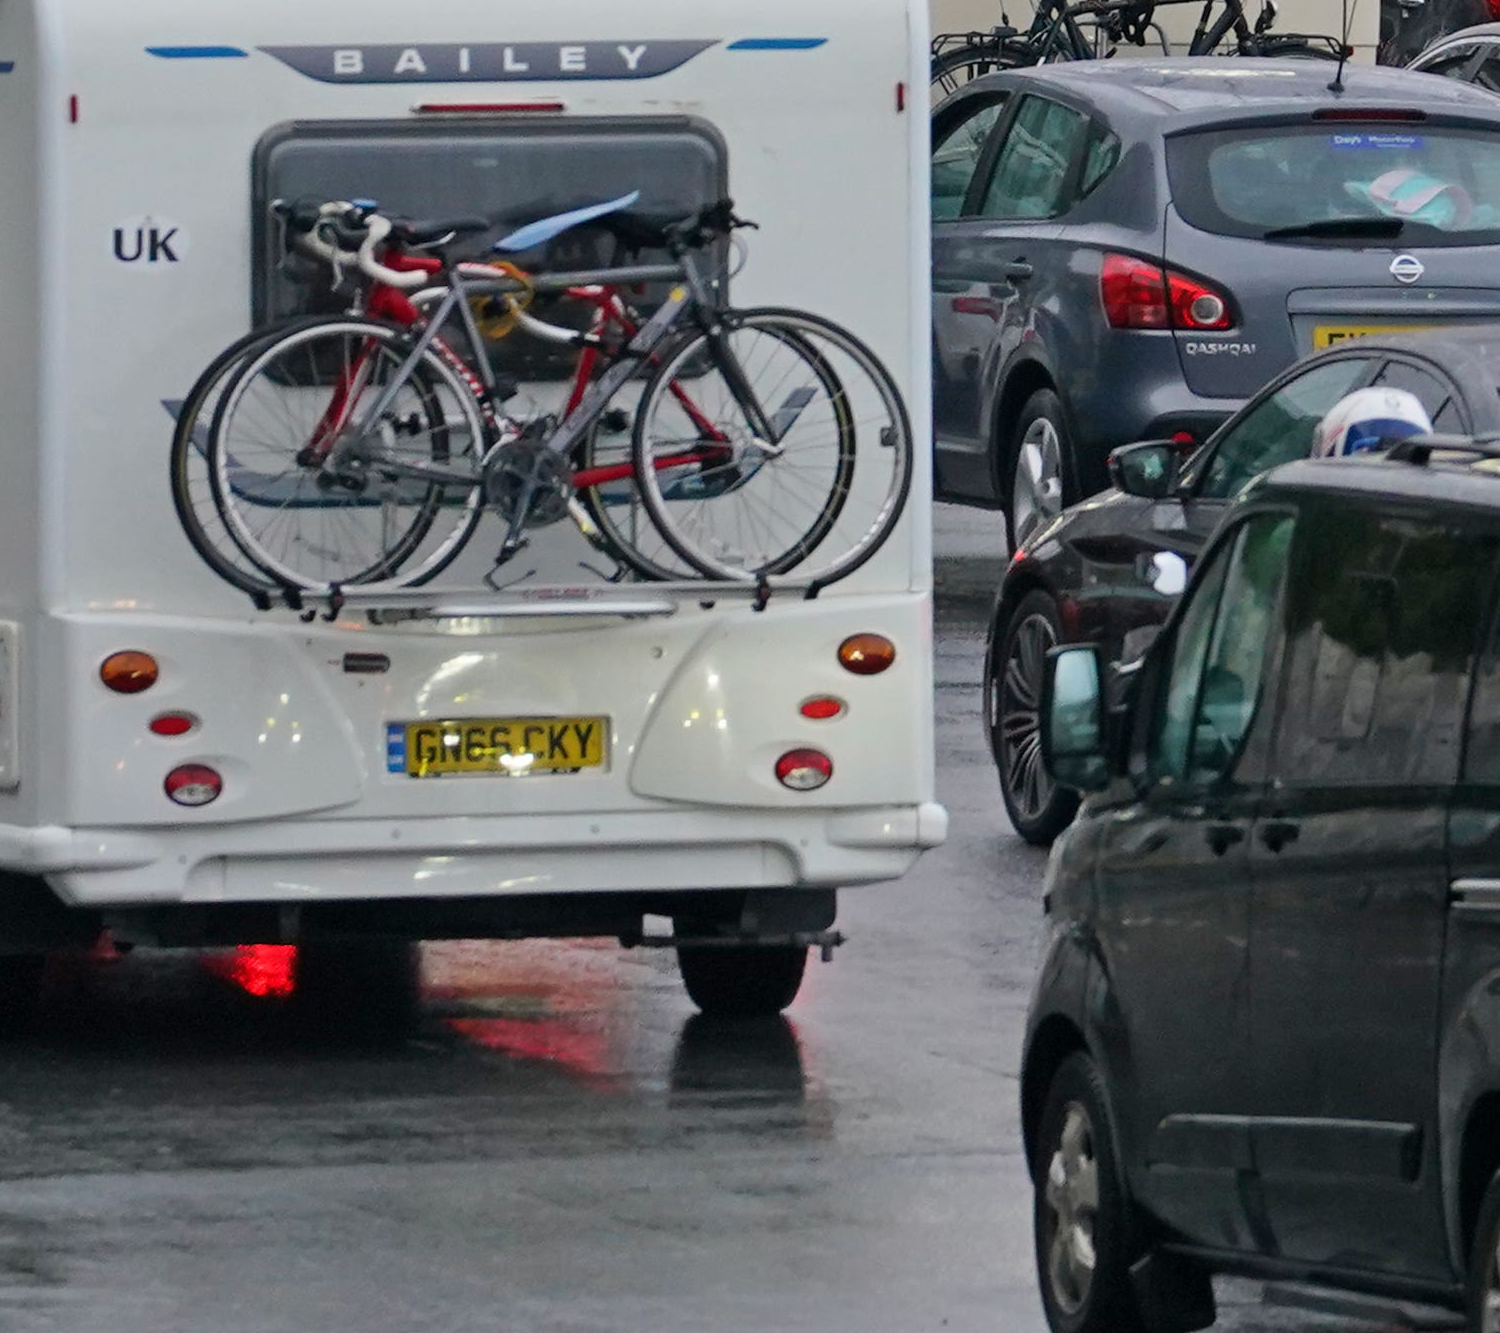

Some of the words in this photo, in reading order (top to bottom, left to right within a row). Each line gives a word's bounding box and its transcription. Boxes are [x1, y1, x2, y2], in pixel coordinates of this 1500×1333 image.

[334, 45, 648, 75] BAILEY
[114, 228, 179, 263] UK
[1186, 343, 1257, 356] QASHQAI
